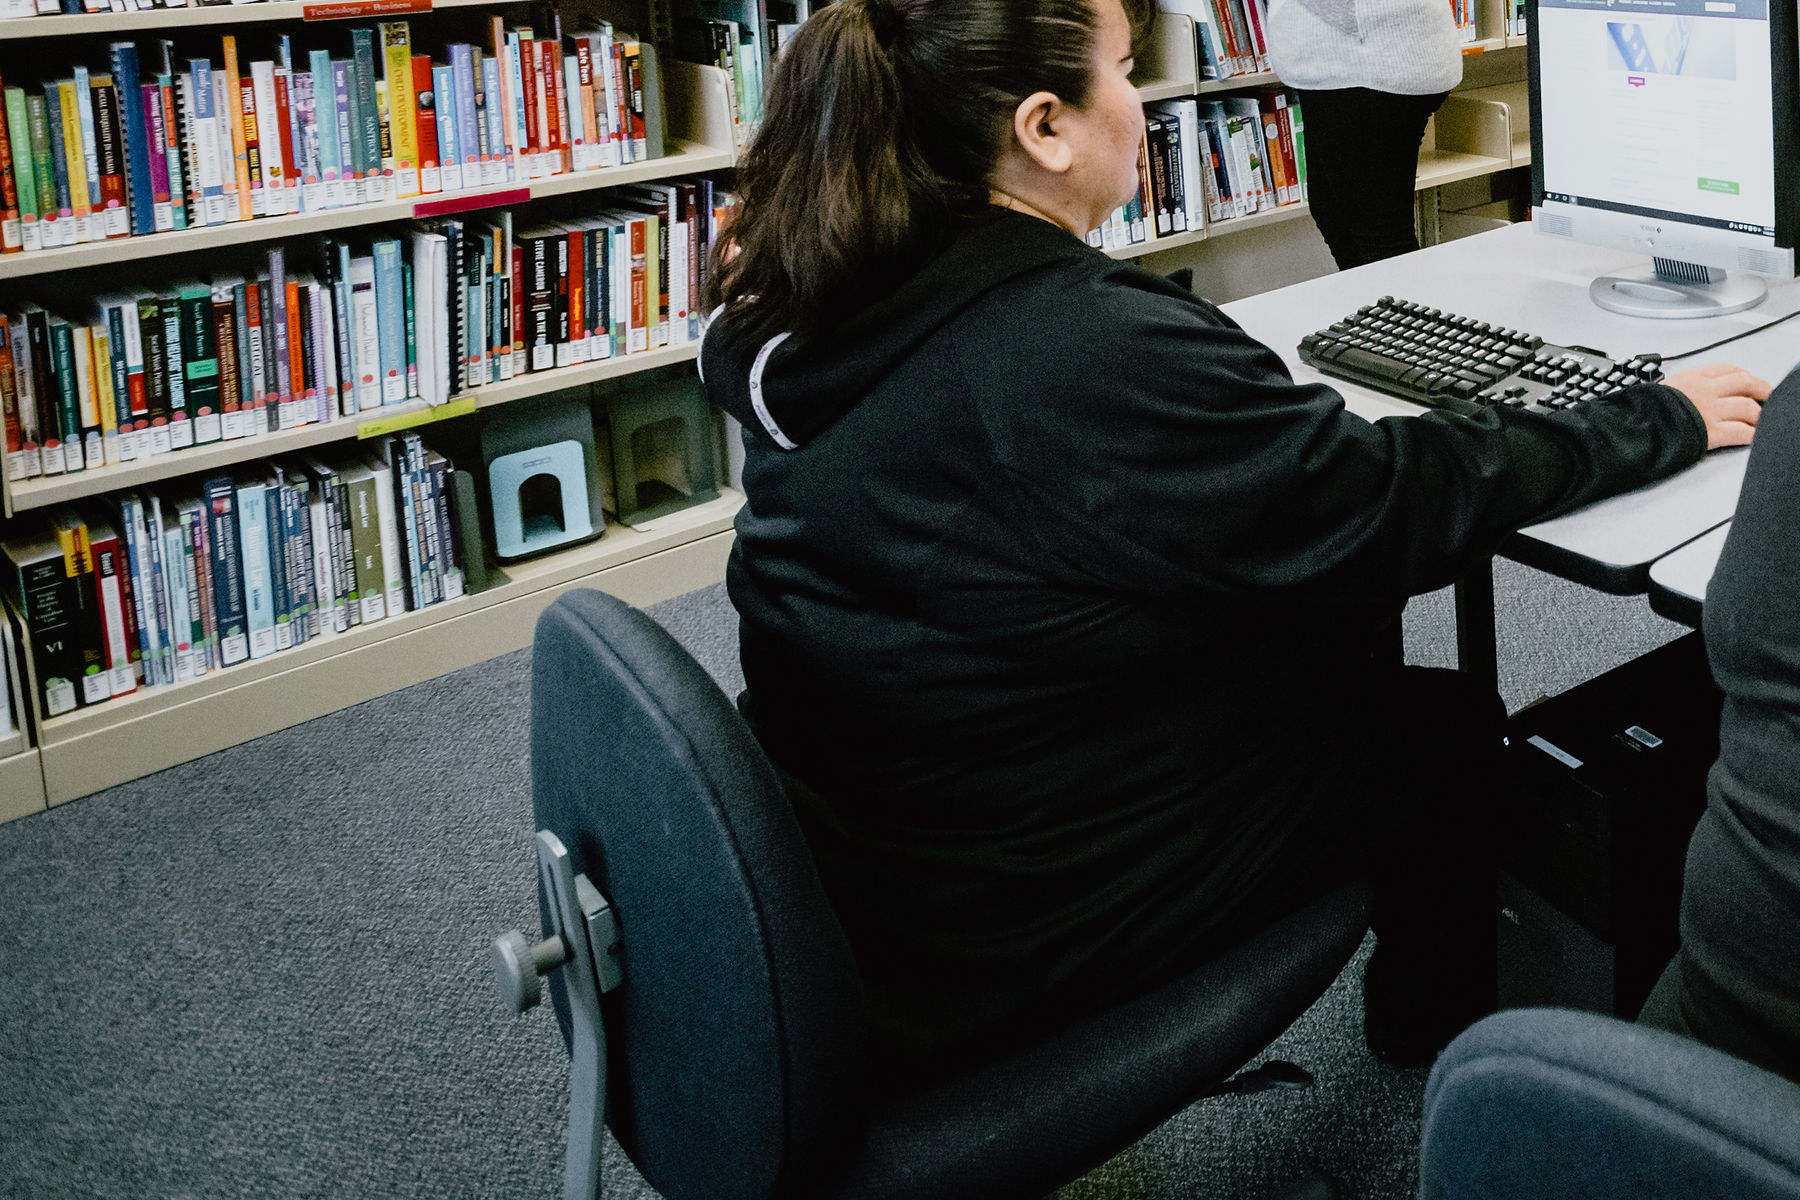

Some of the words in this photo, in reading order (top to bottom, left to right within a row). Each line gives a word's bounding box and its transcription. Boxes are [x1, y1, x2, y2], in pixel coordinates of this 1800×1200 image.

[578, 47, 588, 64] Safe
[393, 69, 403, 93] CHILD
[579, 65, 589, 84] Teen
[97, 88, 108, 108] SOCIAL
[242, 87, 254, 113] DIVORCE
[98, 109, 111, 142] INEQUALITY
[245, 115, 257, 142] BUSTING
[396, 94, 409, 149] DEVELOPMENT
[366, 117, 377, 163] SANTROCK
[104, 151, 115, 174] CANADA
[1172, 146, 1181, 201] MATHEMATICS
[534, 240, 544, 260] STEVIE
[535, 261, 546, 291] CAMERON
[195, 320, 204, 335] Work
[535, 312, 545, 321] ON
[536, 321, 546, 333] THE
[164, 317, 179, 342] STRONG
[152, 354, 160, 371] Work
[250, 329, 262, 378] CRITICAL
[169, 373, 185, 408] TEACHINGS
